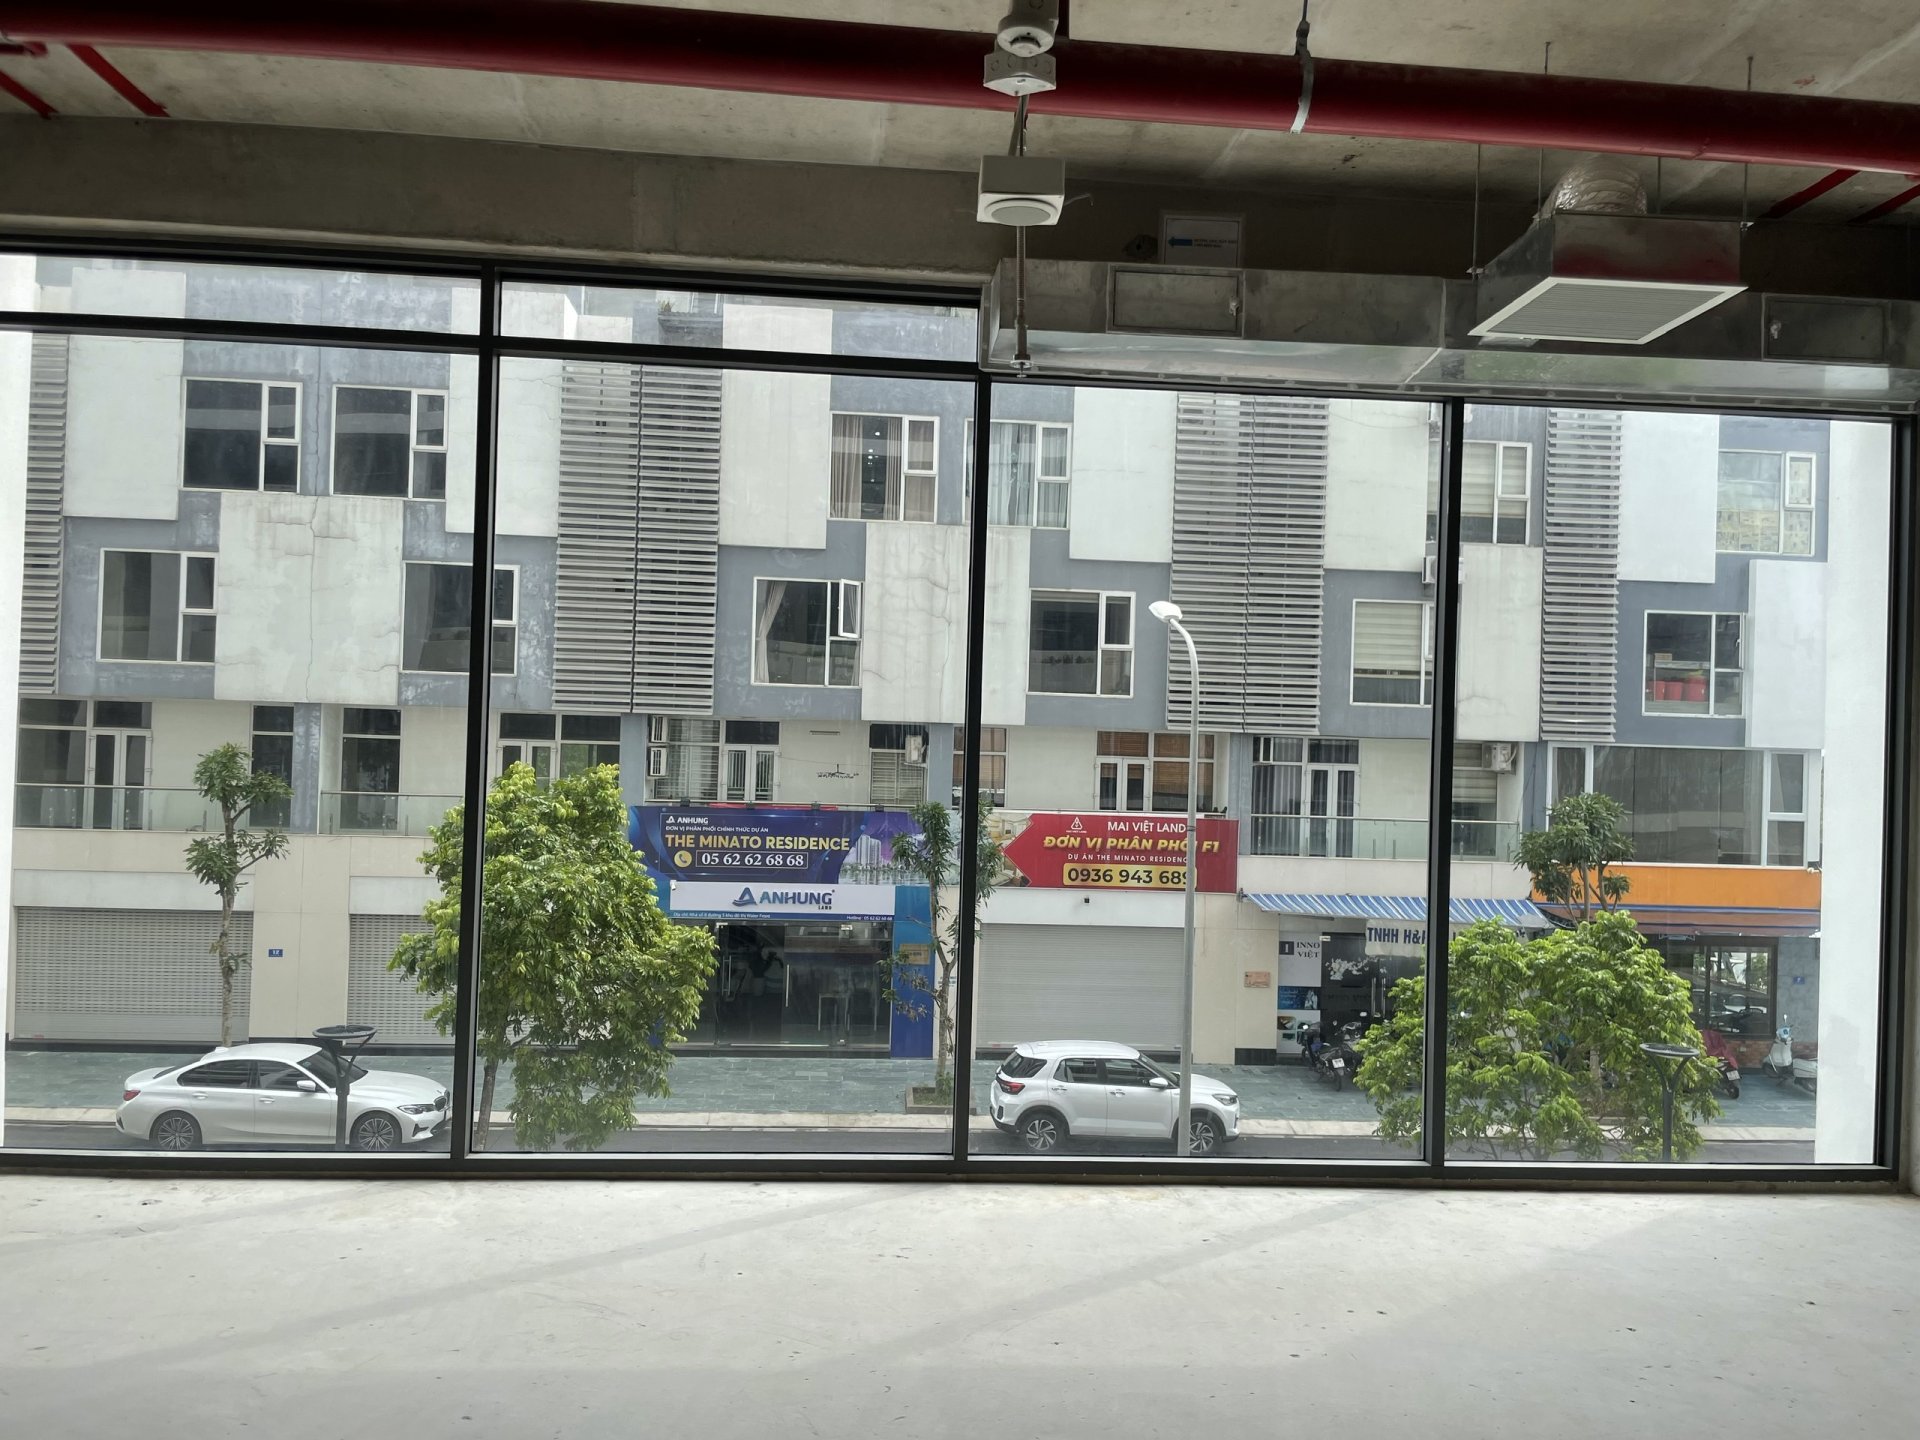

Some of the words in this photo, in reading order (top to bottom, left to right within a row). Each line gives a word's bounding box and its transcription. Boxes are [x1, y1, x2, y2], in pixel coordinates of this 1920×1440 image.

[1107, 821, 1129, 832] MAI
[1132, 820, 1154, 834] VIỆT
[1156, 822, 1187, 833] LAND
[664, 834, 695, 848] THE
[699, 834, 762, 849] MINATO
[765, 836, 850, 851] RESIDENCE
[1043, 834, 1081, 849] ĐƠN
[1086, 837, 1103, 852] VỊ
[1106, 835, 1153, 850] PHÂN
[1201, 840, 1220, 853] F1
[701, 853, 719, 865] 05
[723, 853, 741, 866] 62
[744, 853, 762, 866] 62
[765, 854, 783, 866] 68
[786, 854, 804, 867] 68
[1067, 853, 1079, 861] DỰ
[1082, 852, 1094, 860] ÁN
[1114, 854, 1146, 862] MINATO
[1149, 855, 1187, 863] RESIDENC
[1067, 868, 1114, 883] 0936
[1118, 869, 1153, 884] 943
[759, 891, 833, 905] ANHUNG
[1367, 927, 1399, 944] TNHH
[1296, 941, 1320, 949] INNO
